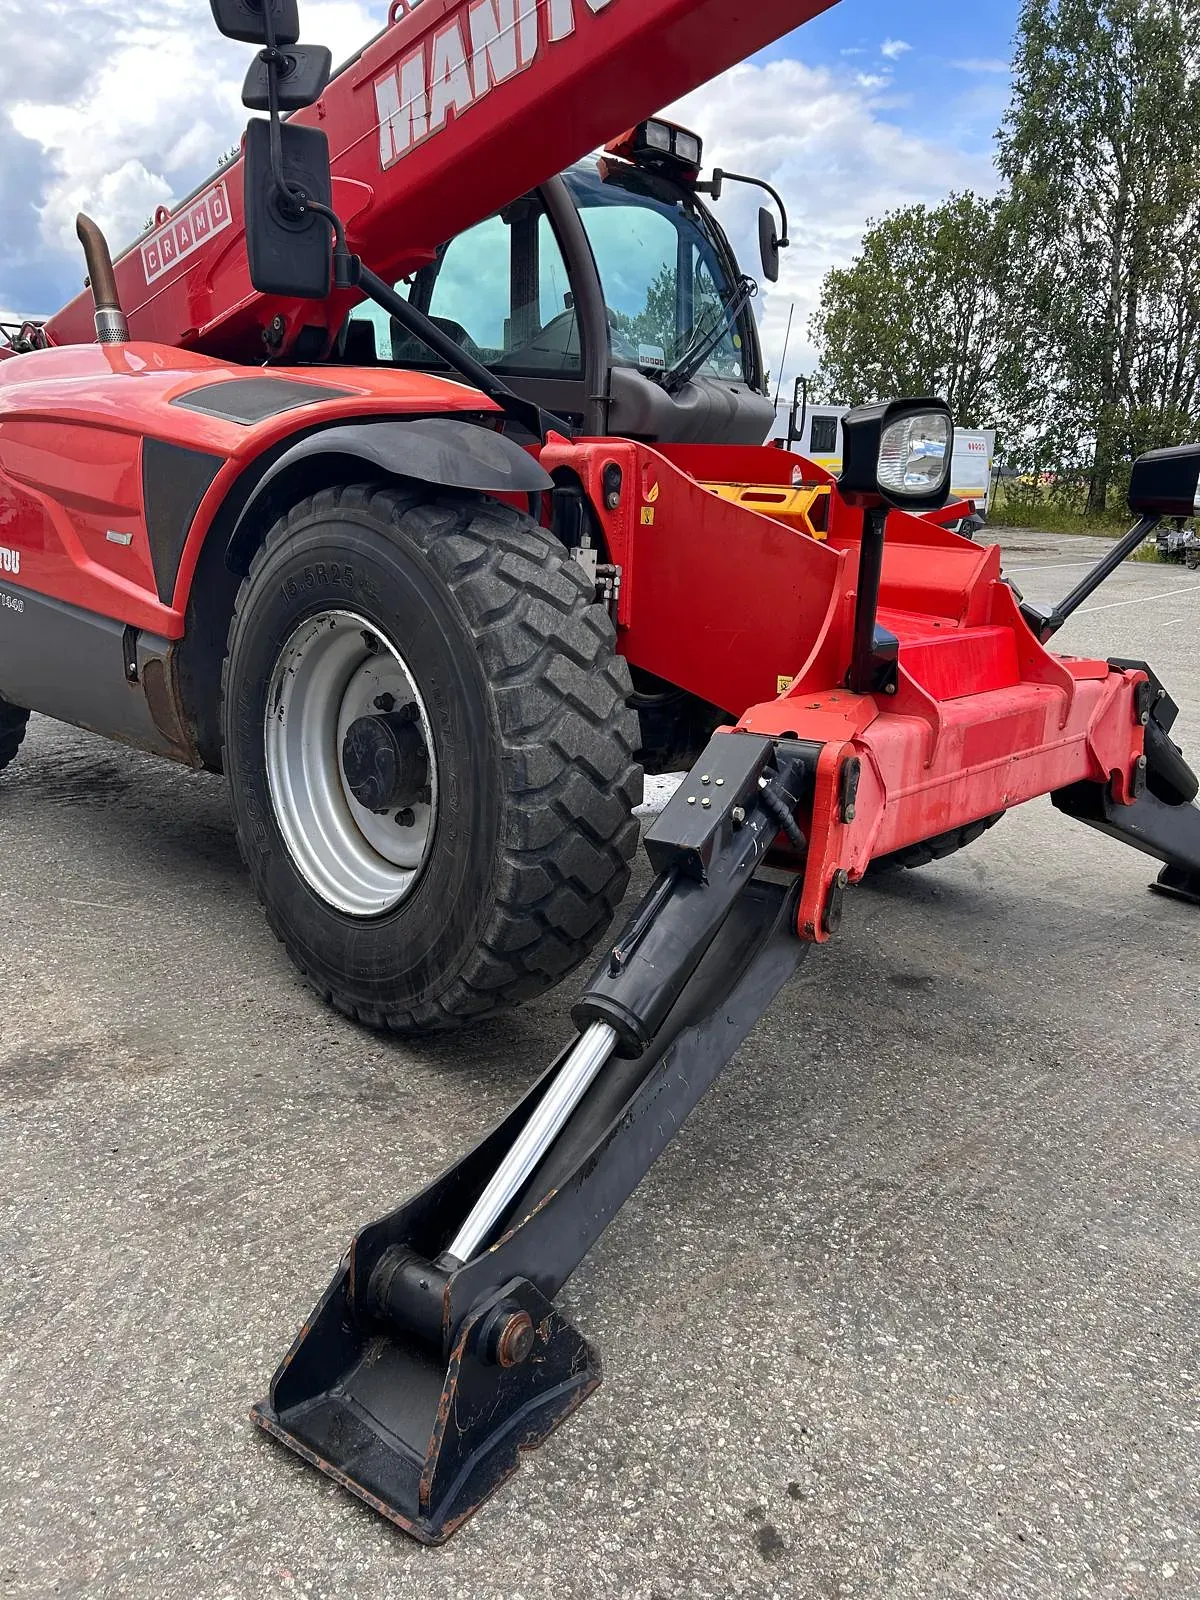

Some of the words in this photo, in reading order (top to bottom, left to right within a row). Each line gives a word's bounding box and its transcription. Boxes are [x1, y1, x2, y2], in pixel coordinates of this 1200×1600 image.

[374, 0, 612, 170] MANI
[147, 198, 223, 269] CRAMO
[281, 560, 354, 602] 15.5R25
